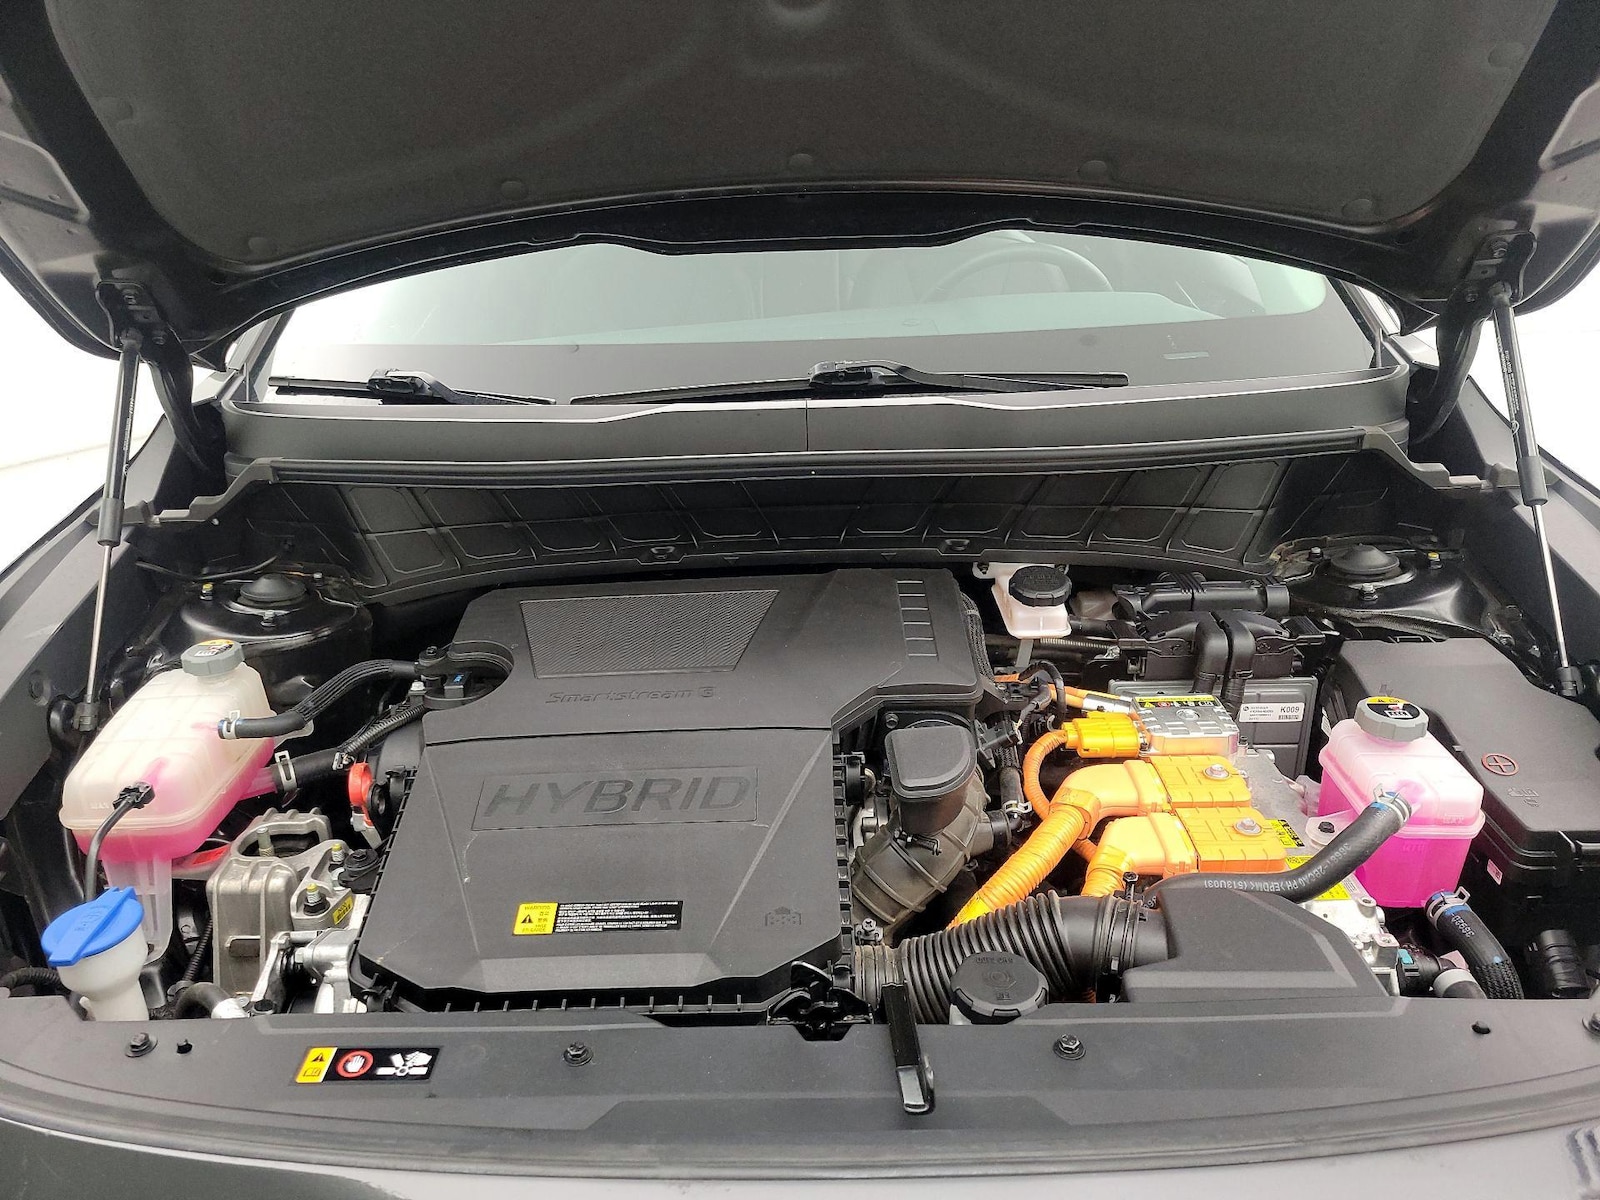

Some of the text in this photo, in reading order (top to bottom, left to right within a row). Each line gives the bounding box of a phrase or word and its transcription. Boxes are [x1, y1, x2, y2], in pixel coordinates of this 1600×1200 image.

[545, 689, 694, 704] Smartstream
[1280, 706, 1300, 714] K009
[483, 776, 750, 817] HYBRID
